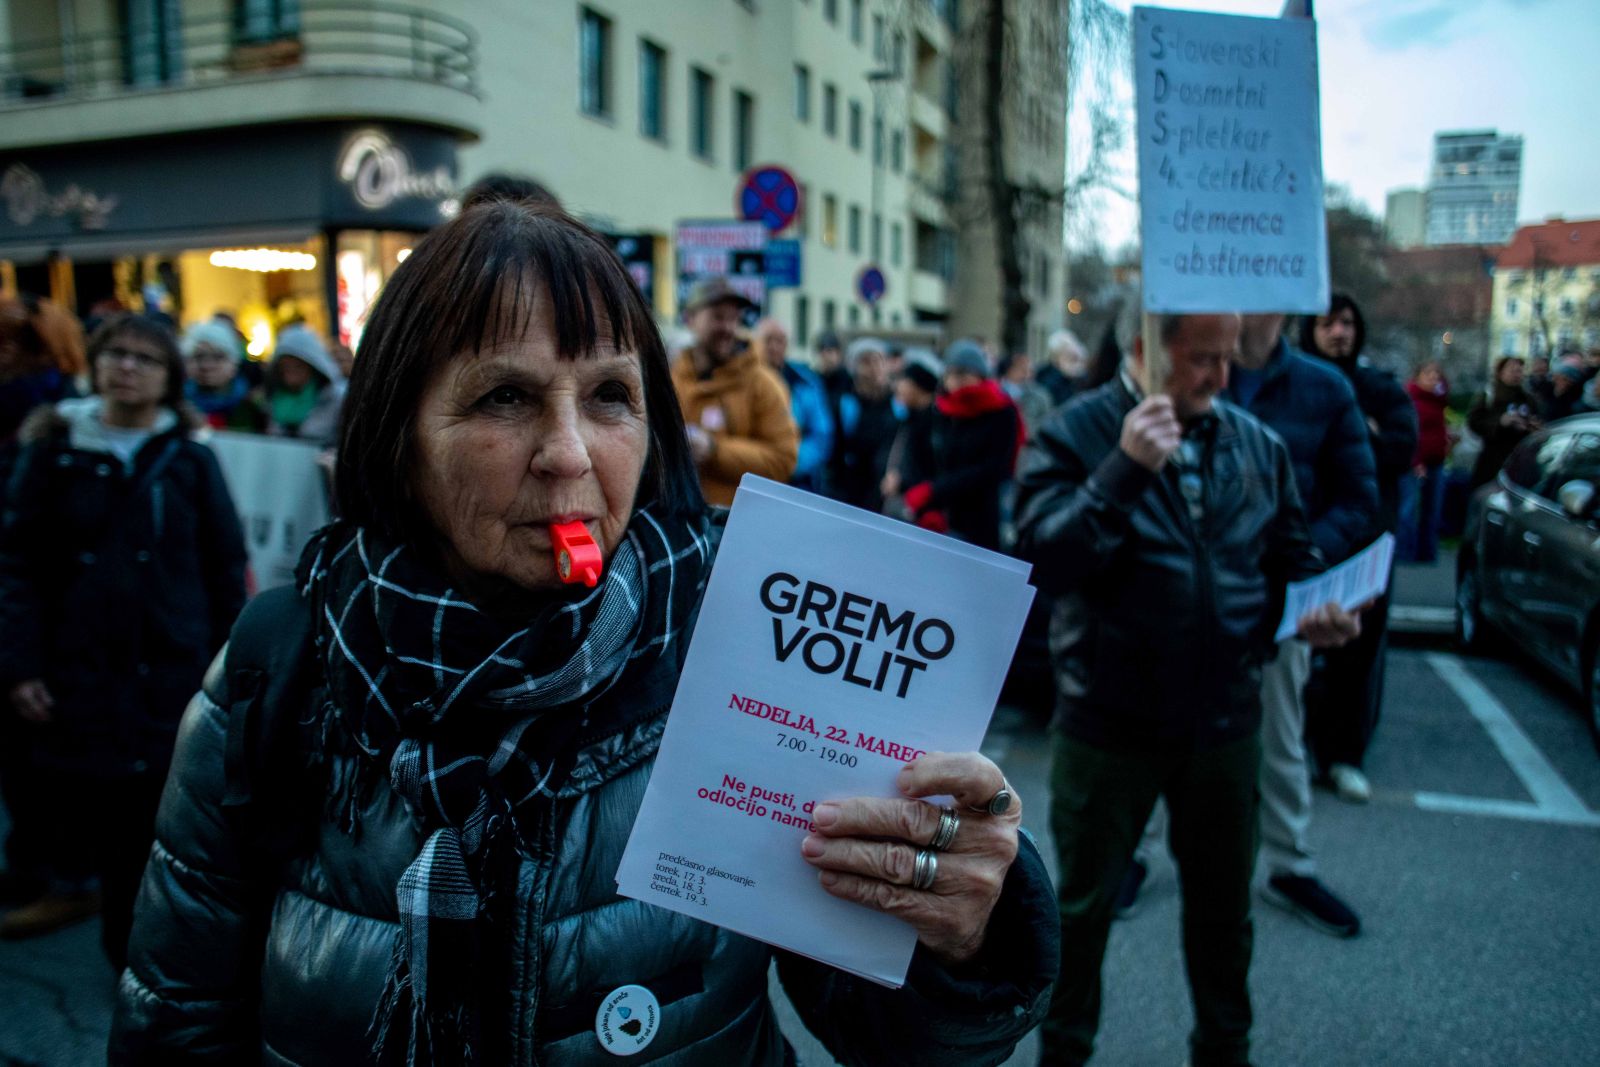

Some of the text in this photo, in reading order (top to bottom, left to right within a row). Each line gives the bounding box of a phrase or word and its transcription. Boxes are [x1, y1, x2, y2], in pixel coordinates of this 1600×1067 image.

[760, 572, 955, 660] GREMO
[772, 616, 928, 699] VOLIT
[728, 694, 820, 738] NEDELJA,
[824, 725, 851, 745] 22.
[776, 732, 808, 753] 7.00
[818, 747, 859, 768] 19.00
[697, 788, 817, 833] odločijo name
[722, 774, 746, 793] Ne
[749, 785, 797, 812] pusti,
[652, 873, 679, 887] sreda,
[682, 881, 695, 892] 18.
[655, 863, 680, 878] torek,
[684, 871, 696, 882] 17.
[658, 852, 756, 888] predčasno glasovanje:
[686, 892, 698, 903] 19.
